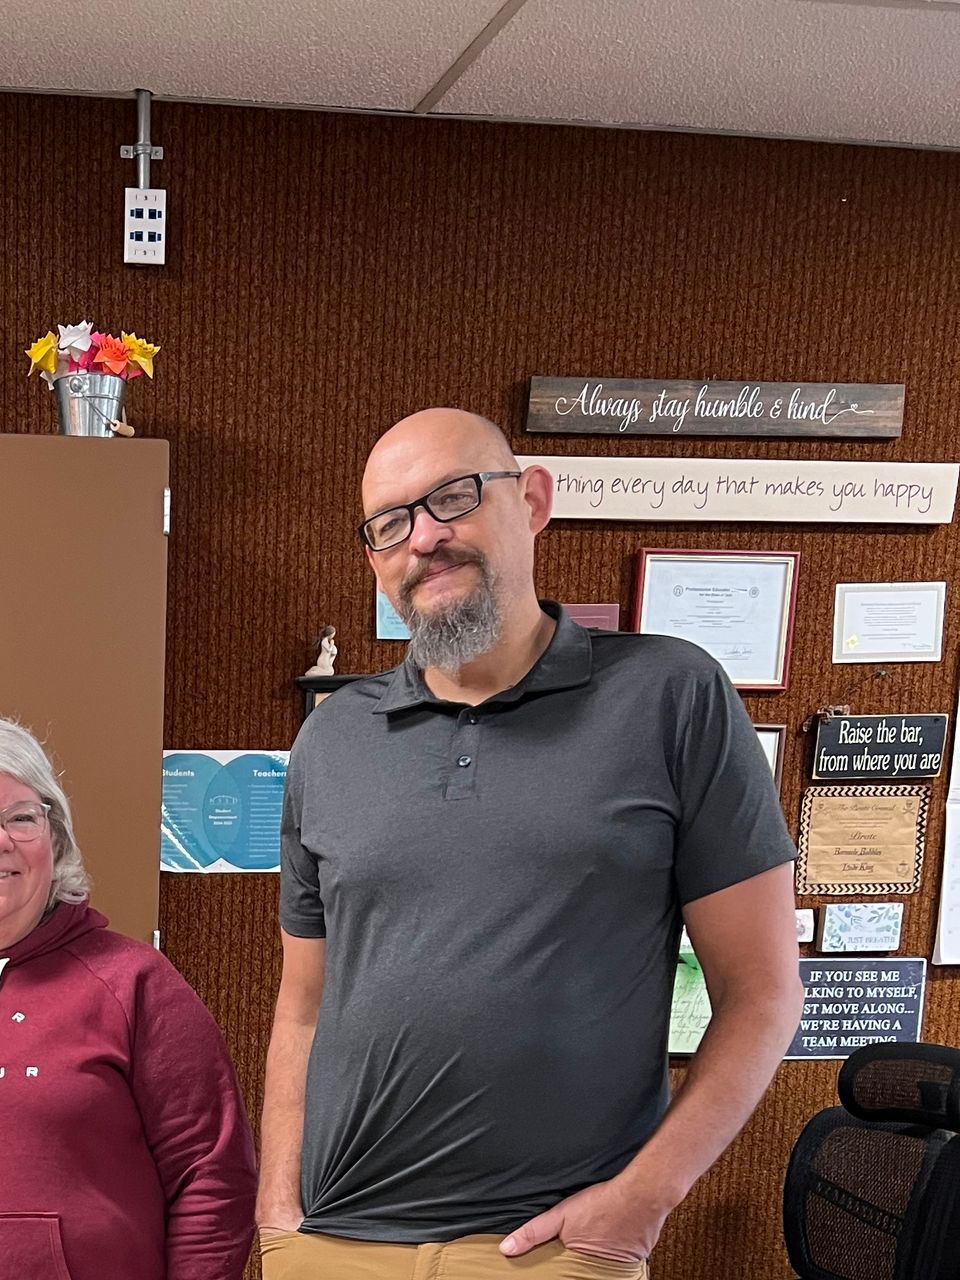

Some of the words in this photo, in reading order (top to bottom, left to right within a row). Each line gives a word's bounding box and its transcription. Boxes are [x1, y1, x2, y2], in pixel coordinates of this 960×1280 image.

[555, 383, 641, 432] Always
[649, 389, 690, 432] stay
[694, 384, 765, 417] humble
[769, 398, 782, 418] &
[787, 388, 837, 424] kind
[557, 474, 604, 507] thing
[611, 477, 665, 508] every
[672, 475, 709, 509] day
[716, 475, 759, 494] that
[764, 476, 824, 497] makes
[829, 482, 865, 511] you
[874, 479, 933, 513] happy
[839, 720, 873, 744] Raise
[876, 719, 897, 743] the
[900, 719, 923, 746] bar,
[819, 747, 849, 771] from
[852, 746, 890, 770] where
[892, 753, 918, 775] you
[919, 752, 941, 769] are
[162, 769, 195, 777] Students
[809, 971, 823, 982] IF
[824, 971, 852, 982] YOU
[854, 971, 878, 982] SEE
[880, 971, 900, 982] ME
[804, 988, 843, 998] LKING
[846, 988, 864, 998] TO
[866, 987, 918, 999] MYSELF,
[803, 1004, 819, 1014] ST
[821, 1004, 859, 1014] MOVE
[861, 1004, 915, 1014] ALONG...
[801, 1020, 840, 1031] WE'RE
[842, 1020, 891, 1031] HAVING
[892, 1020, 902, 1030] A
[802, 1036, 838, 1047] TEAM
